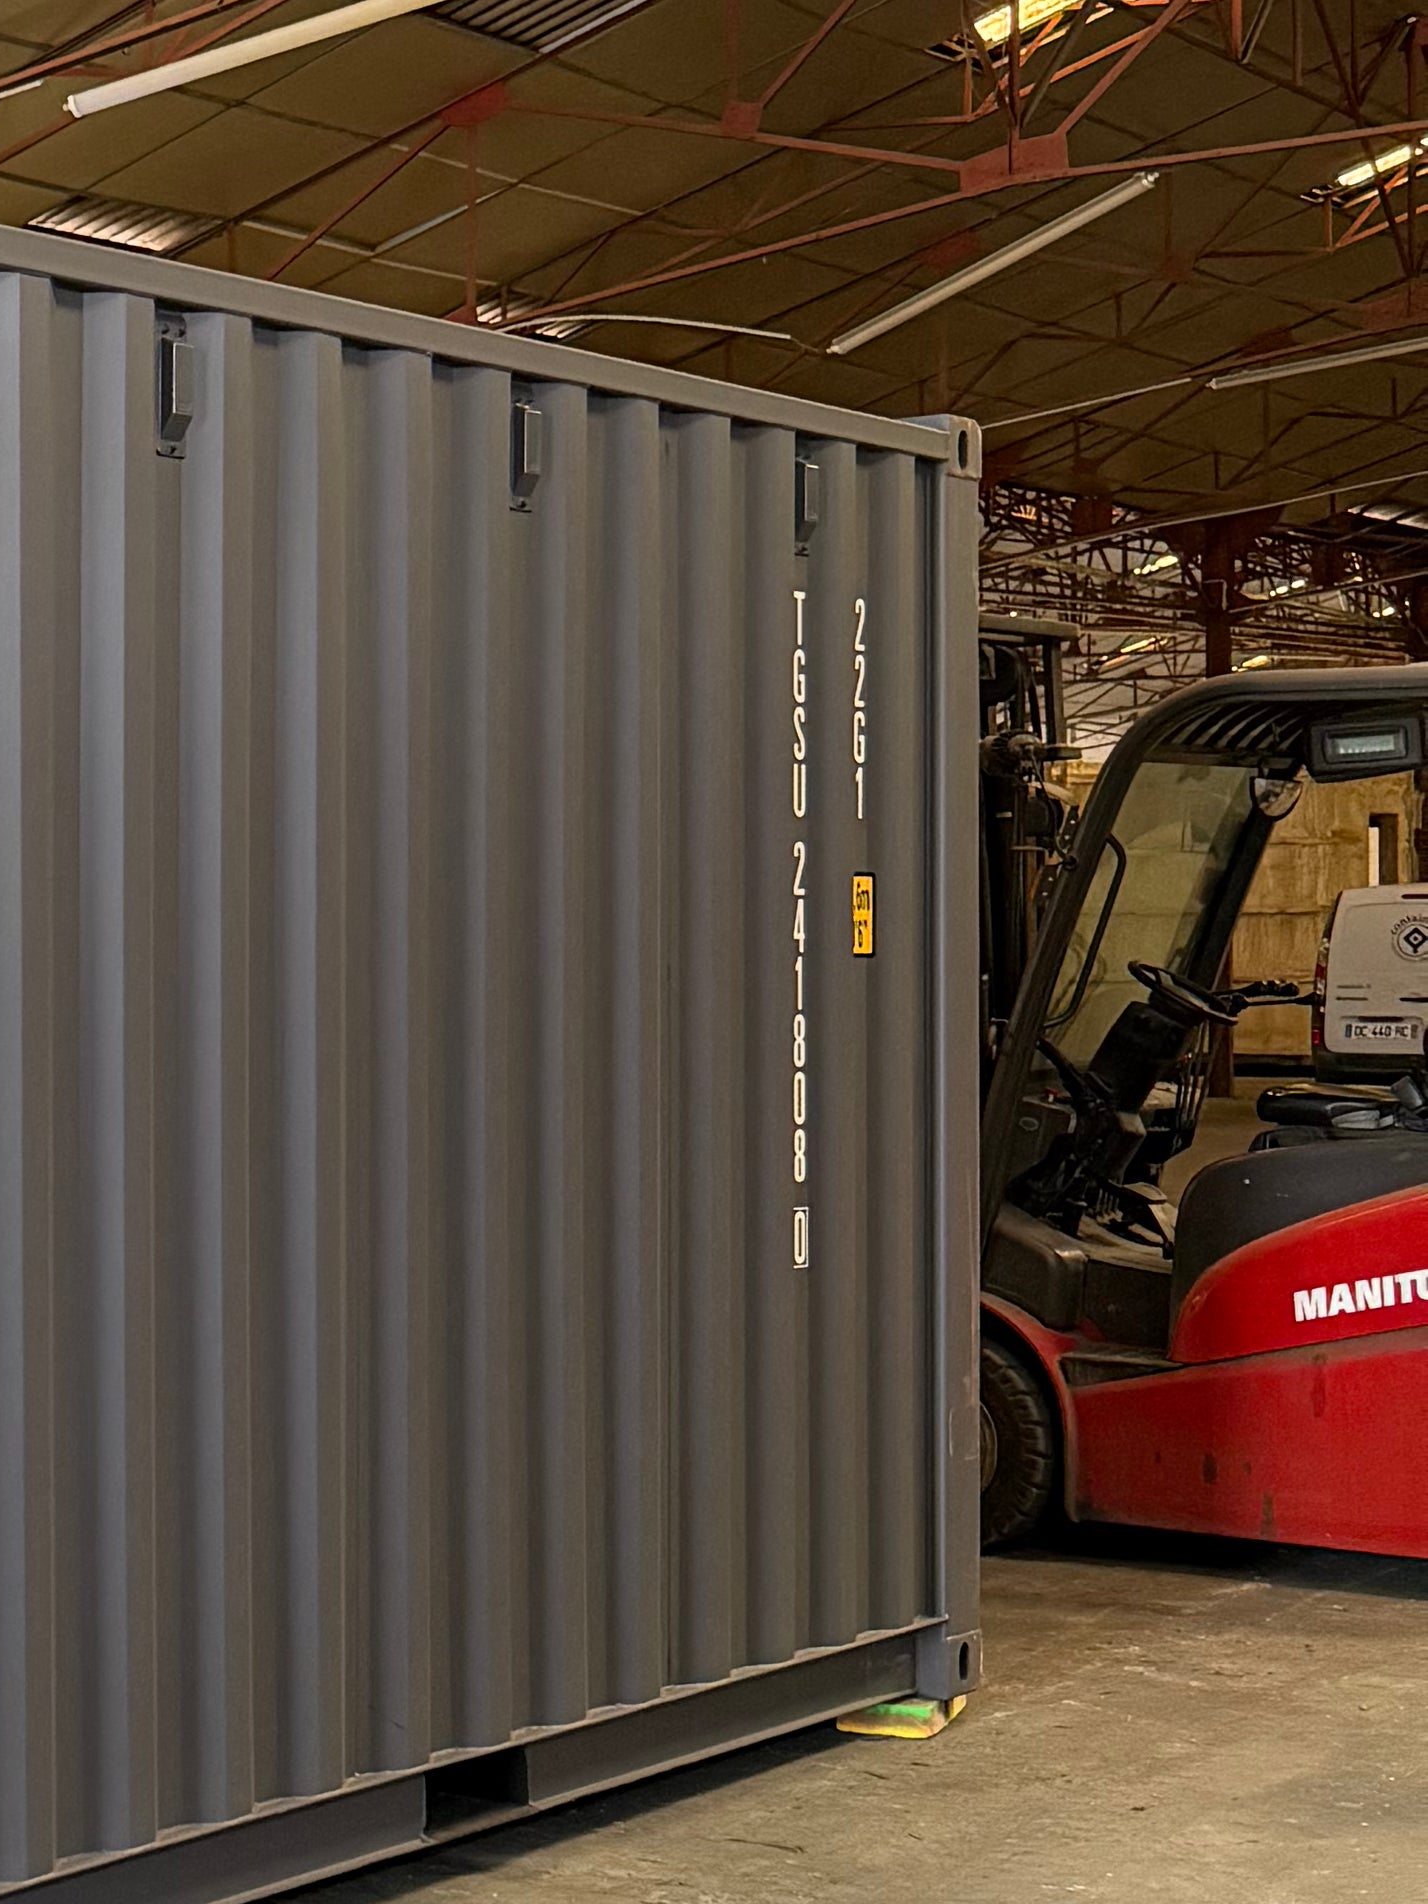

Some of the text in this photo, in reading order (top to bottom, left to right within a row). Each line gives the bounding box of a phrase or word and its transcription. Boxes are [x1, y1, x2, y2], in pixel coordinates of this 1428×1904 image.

[793, 590, 806, 1265] TGSU 241808 0
[853, 598, 866, 820] 22G1
